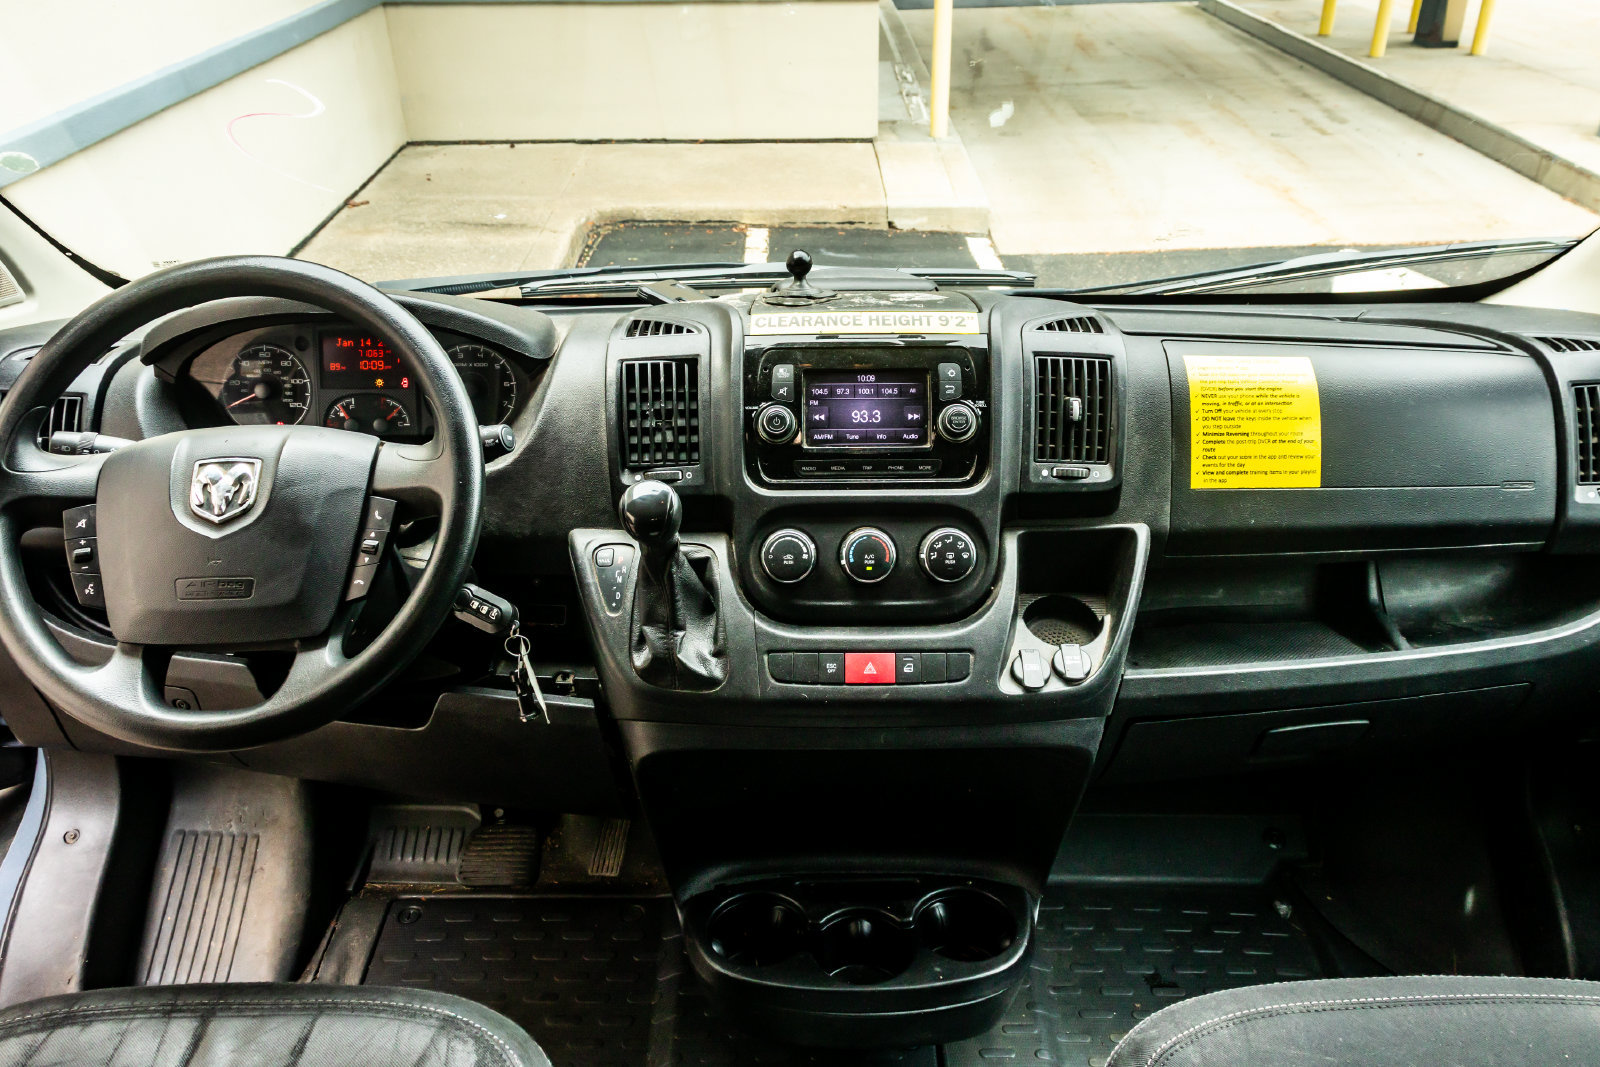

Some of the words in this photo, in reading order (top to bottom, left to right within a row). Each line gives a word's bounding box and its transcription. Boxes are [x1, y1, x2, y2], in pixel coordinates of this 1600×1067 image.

[755, 314, 863, 328] CLEARANCE
[868, 314, 934, 327] HEIGHT
[336, 338, 354, 347] Jan
[360, 338, 372, 346] 14
[358, 350, 384, 358] 71063
[360, 360, 384, 370] 10:09
[852, 410, 881, 422] 93.3
